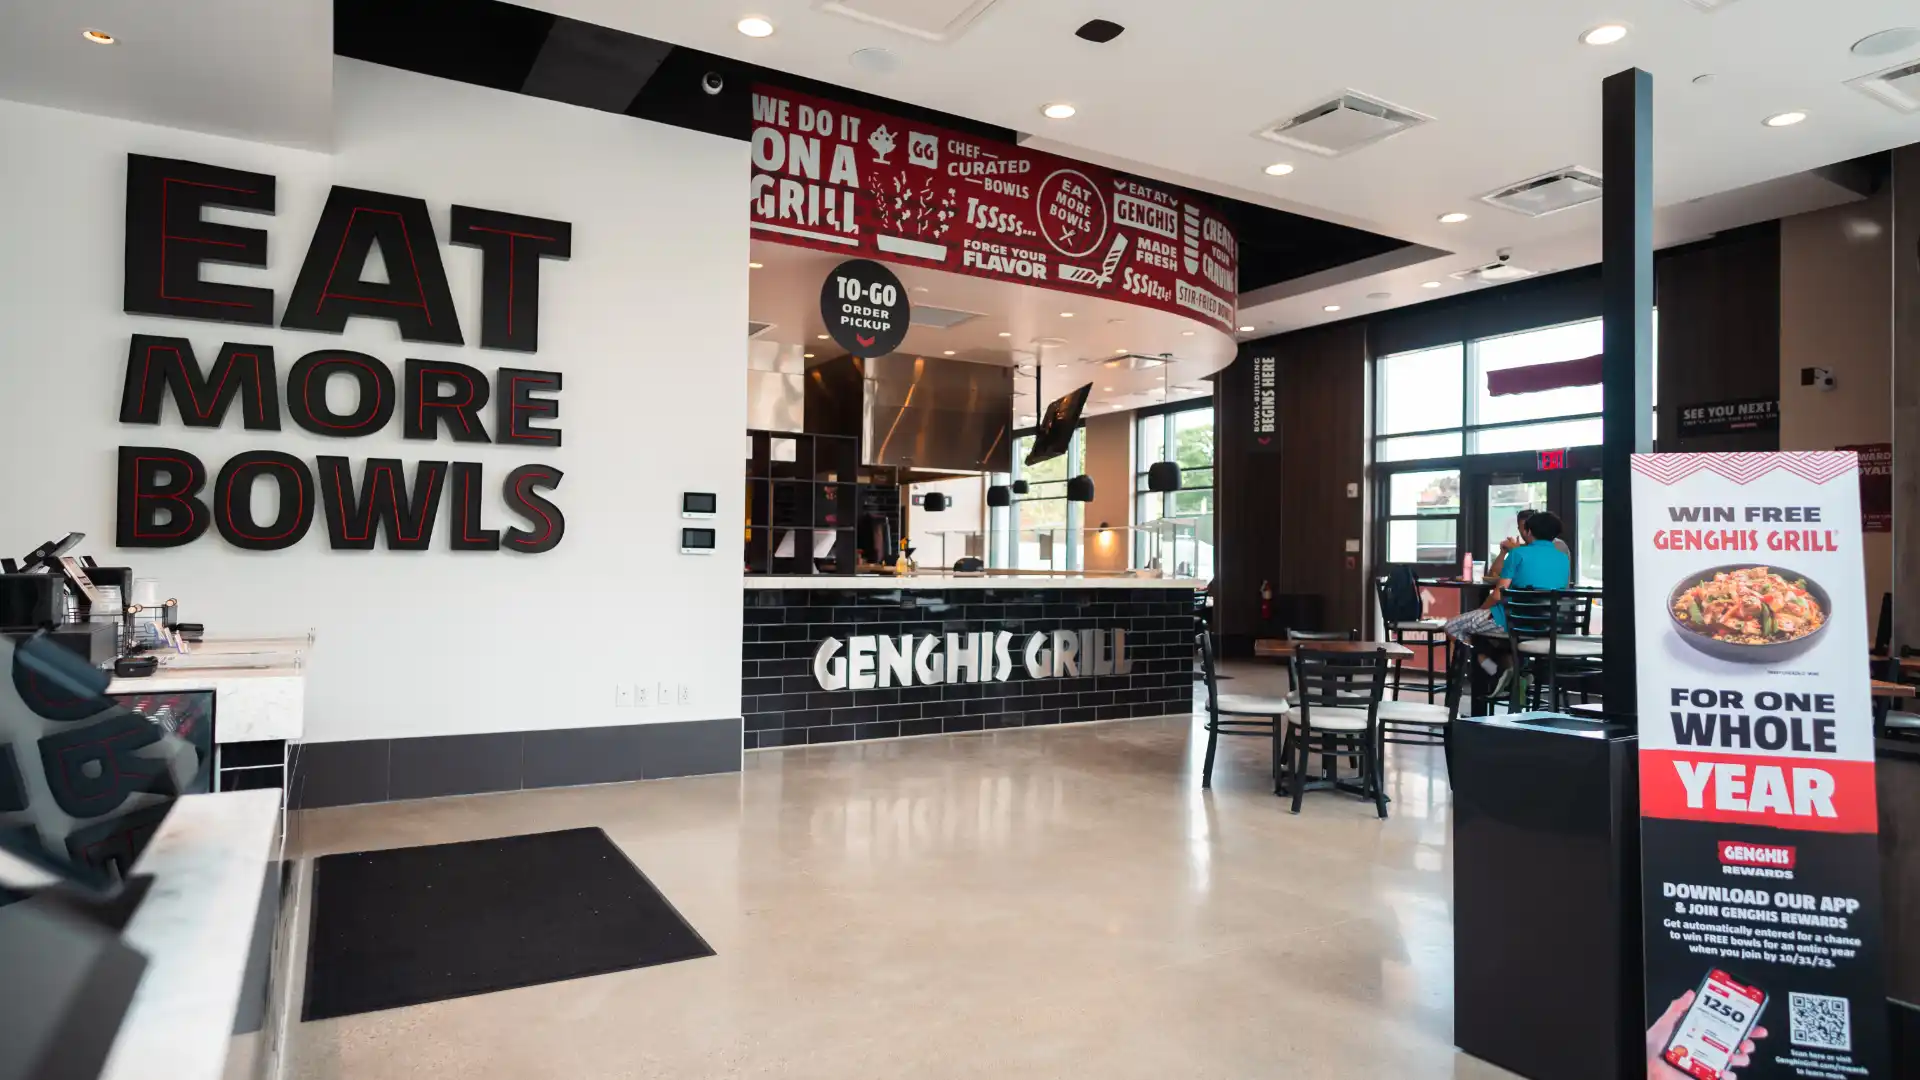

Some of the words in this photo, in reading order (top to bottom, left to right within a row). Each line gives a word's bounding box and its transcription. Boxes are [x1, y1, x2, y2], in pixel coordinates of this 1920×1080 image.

[752, 93, 790, 128] WE
[798, 104, 833, 136] DO
[840, 114, 861, 143] IT
[751, 127, 821, 180] ON
[829, 143, 860, 188] A
[912, 140, 935, 161] GG
[947, 140, 981, 159] CHEF
[947, 160, 1031, 177] CURATED
[984, 178, 1030, 199] BOWLS
[1061, 179, 1092, 202] EAT
[1129, 183, 1153, 198] EAT
[1154, 191, 1169, 204] AT
[751, 174, 860, 234] GRILL
[1055, 191, 1092, 218] MORE
[1117, 200, 1175, 234] GENGHIS
[1049, 203, 1092, 233] BOWLS
[124, 153, 572, 352] EAT
[963, 239, 1008, 256] FORGE
[1011, 248, 1047, 263] YOUR
[1136, 249, 1178, 272] FRESH
[1137, 237, 1177, 259] MADE
[1211, 245, 1230, 267] YOUR
[963, 250, 1048, 280] FLAVOR
[837, 276, 897, 307] TO-GO
[1179, 286, 1217, 314] STIR-FRIED
[840, 315, 891, 331] PICKUP
[842, 303, 889, 319] ORDER
[1261, 357, 1275, 387] HERE
[119, 334, 563, 447] MORE
[1253, 358, 1261, 432] BOWL-BUILDING
[1261, 389, 1275, 432] BEGINS
[1683, 408, 1705, 419] SEE
[1708, 405, 1734, 418] YOU
[1738, 401, 1773, 414] NEXT
[116, 445, 566, 553] BOWLS
[1668, 507, 1735, 522] WIN
[1745, 507, 1821, 522] FREE
[1653, 530, 1758, 551] GENGHIS
[813, 630, 1013, 690] GENGHIS
[1024, 628, 1133, 680] GRILL
[1670, 688, 1744, 709] FOR
[1754, 691, 1835, 713] ONE
[1670, 711, 1837, 753] WHOLE
[1672, 760, 1838, 818] YEAR
[1724, 845, 1789, 864] GENGHIS
[1722, 865, 1794, 879] REWARDS
[1663, 882, 1770, 907] DOWNLOAD
[1774, 892, 1817, 910] OUR
[1820, 896, 1860, 914] APP
[1675, 902, 1686, 914] &
[1688, 904, 1719, 918] JOIN
[1721, 907, 1779, 923] GENGHIS
[1781, 912, 1848, 929] REWARDS
[1663, 918, 1681, 928] Get
[1682, 920, 1752, 937] automatically
[1754, 927, 1795, 940] entered
[1797, 930, 1812, 941] for
[1814, 934, 1822, 943] a
[1824, 934, 1862, 946] chance
[1669, 930, 1681, 940] to
[1682, 932, 1702, 943] win
[1703, 933, 1729, 944] FREE
[1730, 935, 1762, 948] bowls
[1763, 938, 1779, 949] for
[1780, 941, 1795, 951] an
[1796, 942, 1829, 955] entire
[1830, 946, 1855, 958] year
[1689, 943, 1718, 955] when
[1719, 948, 1740, 959] you
[1741, 948, 1762, 960] join
[1763, 951, 1777, 964] by
[1702, 994, 1745, 1023] 1250
